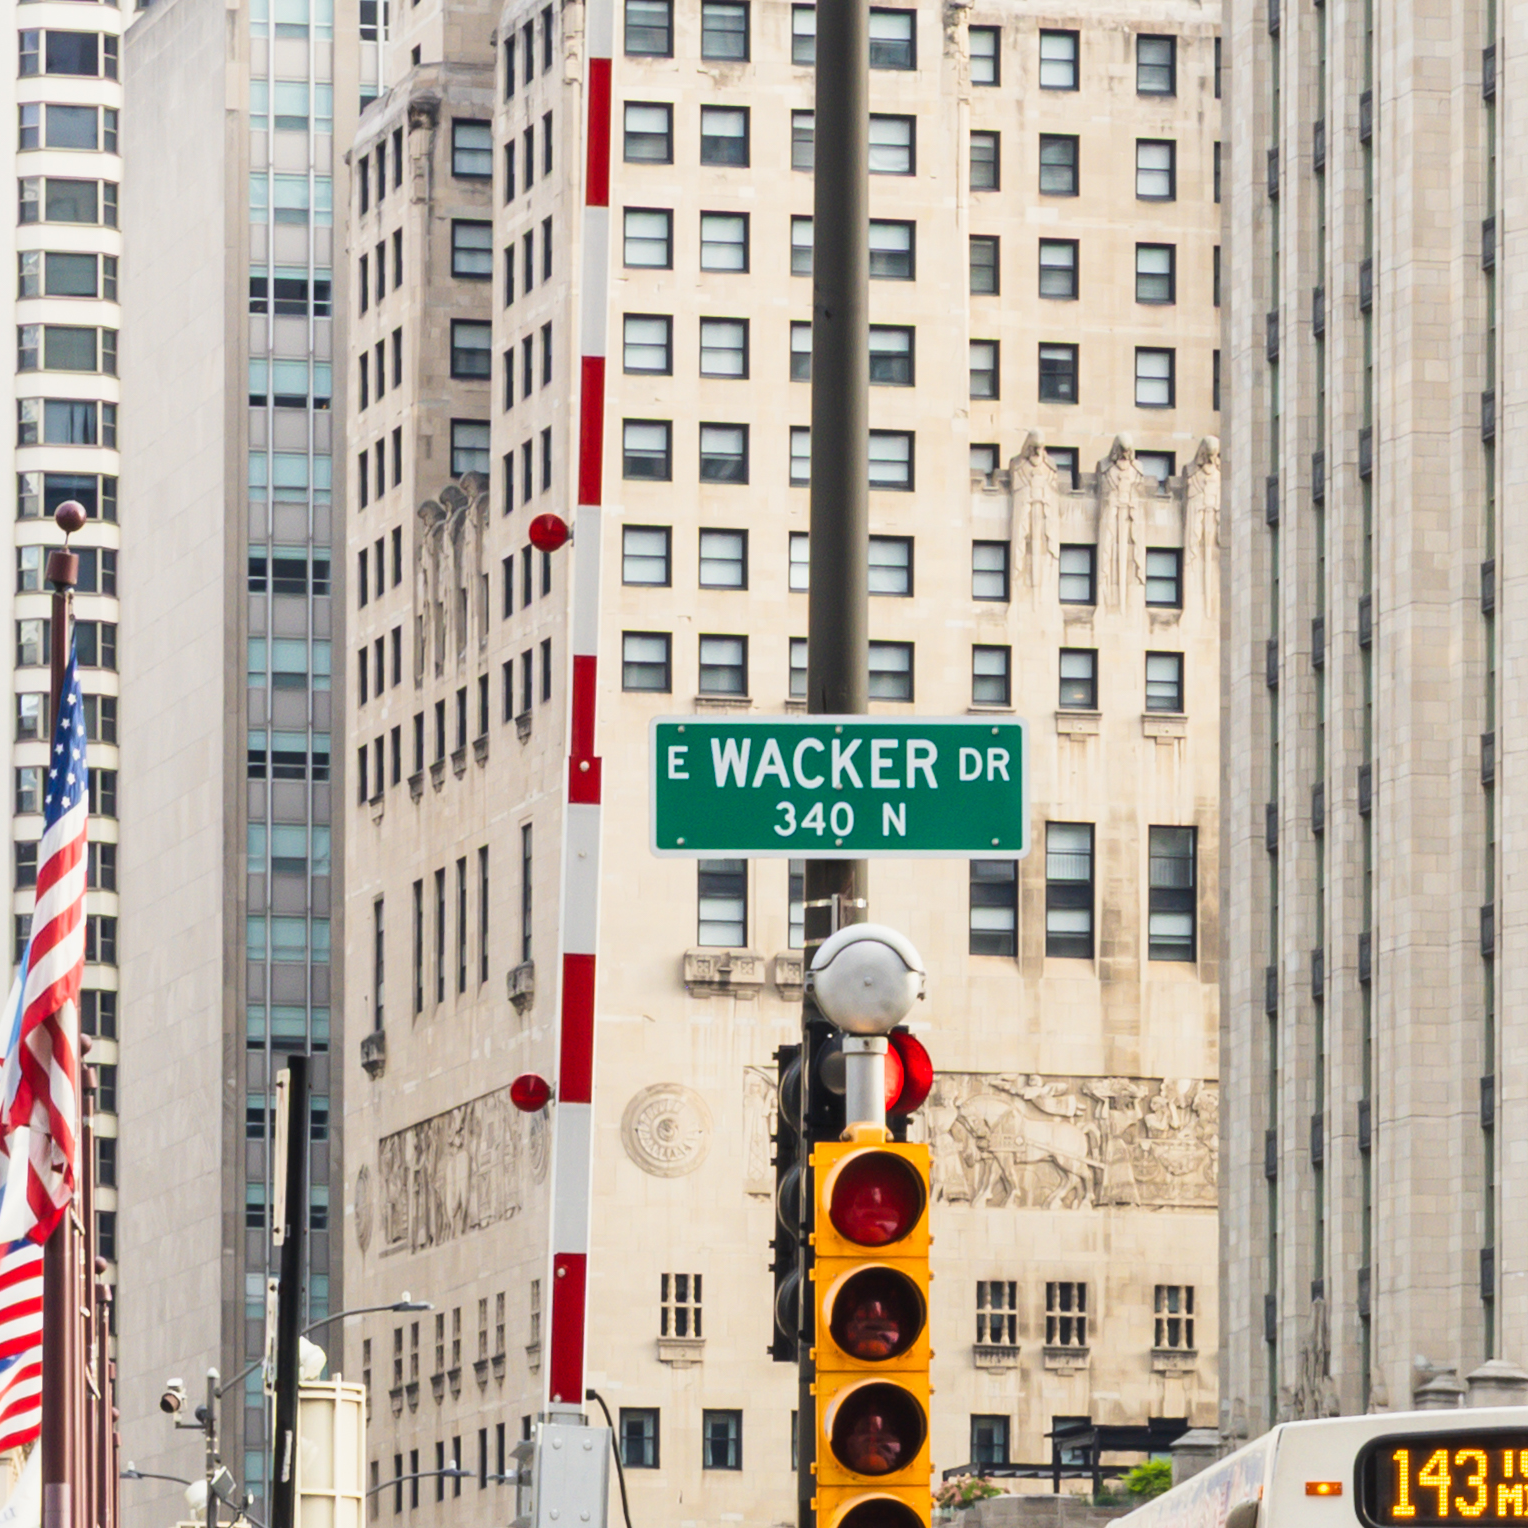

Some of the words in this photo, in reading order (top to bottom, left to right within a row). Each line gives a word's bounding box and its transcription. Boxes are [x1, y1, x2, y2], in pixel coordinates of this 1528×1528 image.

[668, 745, 690, 779] E
[710, 737, 939, 790] WACKER
[959, 747, 1011, 782] DR
[773, 801, 855, 838] 340
[882, 802, 907, 837] N
[1392, 1449, 1489, 1518] 143
